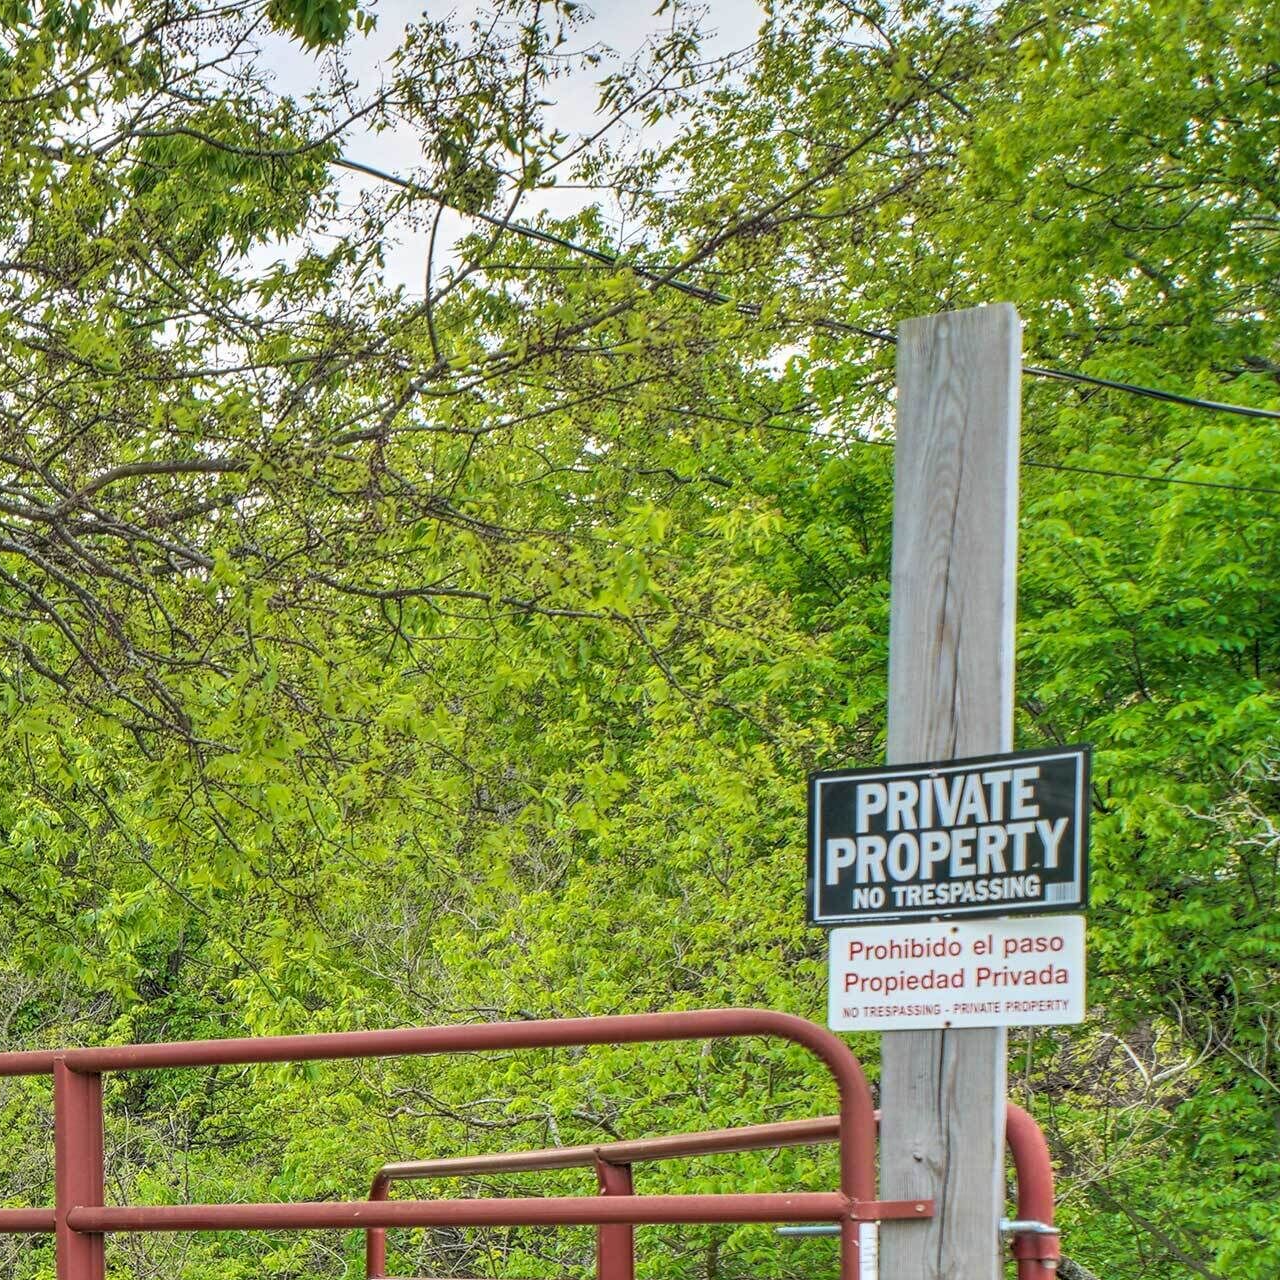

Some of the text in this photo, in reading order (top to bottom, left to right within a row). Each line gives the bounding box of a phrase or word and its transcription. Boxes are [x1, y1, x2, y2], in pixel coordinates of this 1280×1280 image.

[855, 766, 1040, 834] PRIVATE
[825, 817, 1069, 886] PROPERTY
[852, 875, 1041, 910] NO TRESPASSING
[848, 934, 1065, 961] Prohibido el paso
[844, 964, 1069, 996] Propiedad Privada
[841, 1006, 860, 1019] NO
[863, 1003, 942, 1018] TRESPASSING
[953, 1001, 1002, 1016] PRIVATE
[1004, 999, 1070, 1014] PROPERTY
